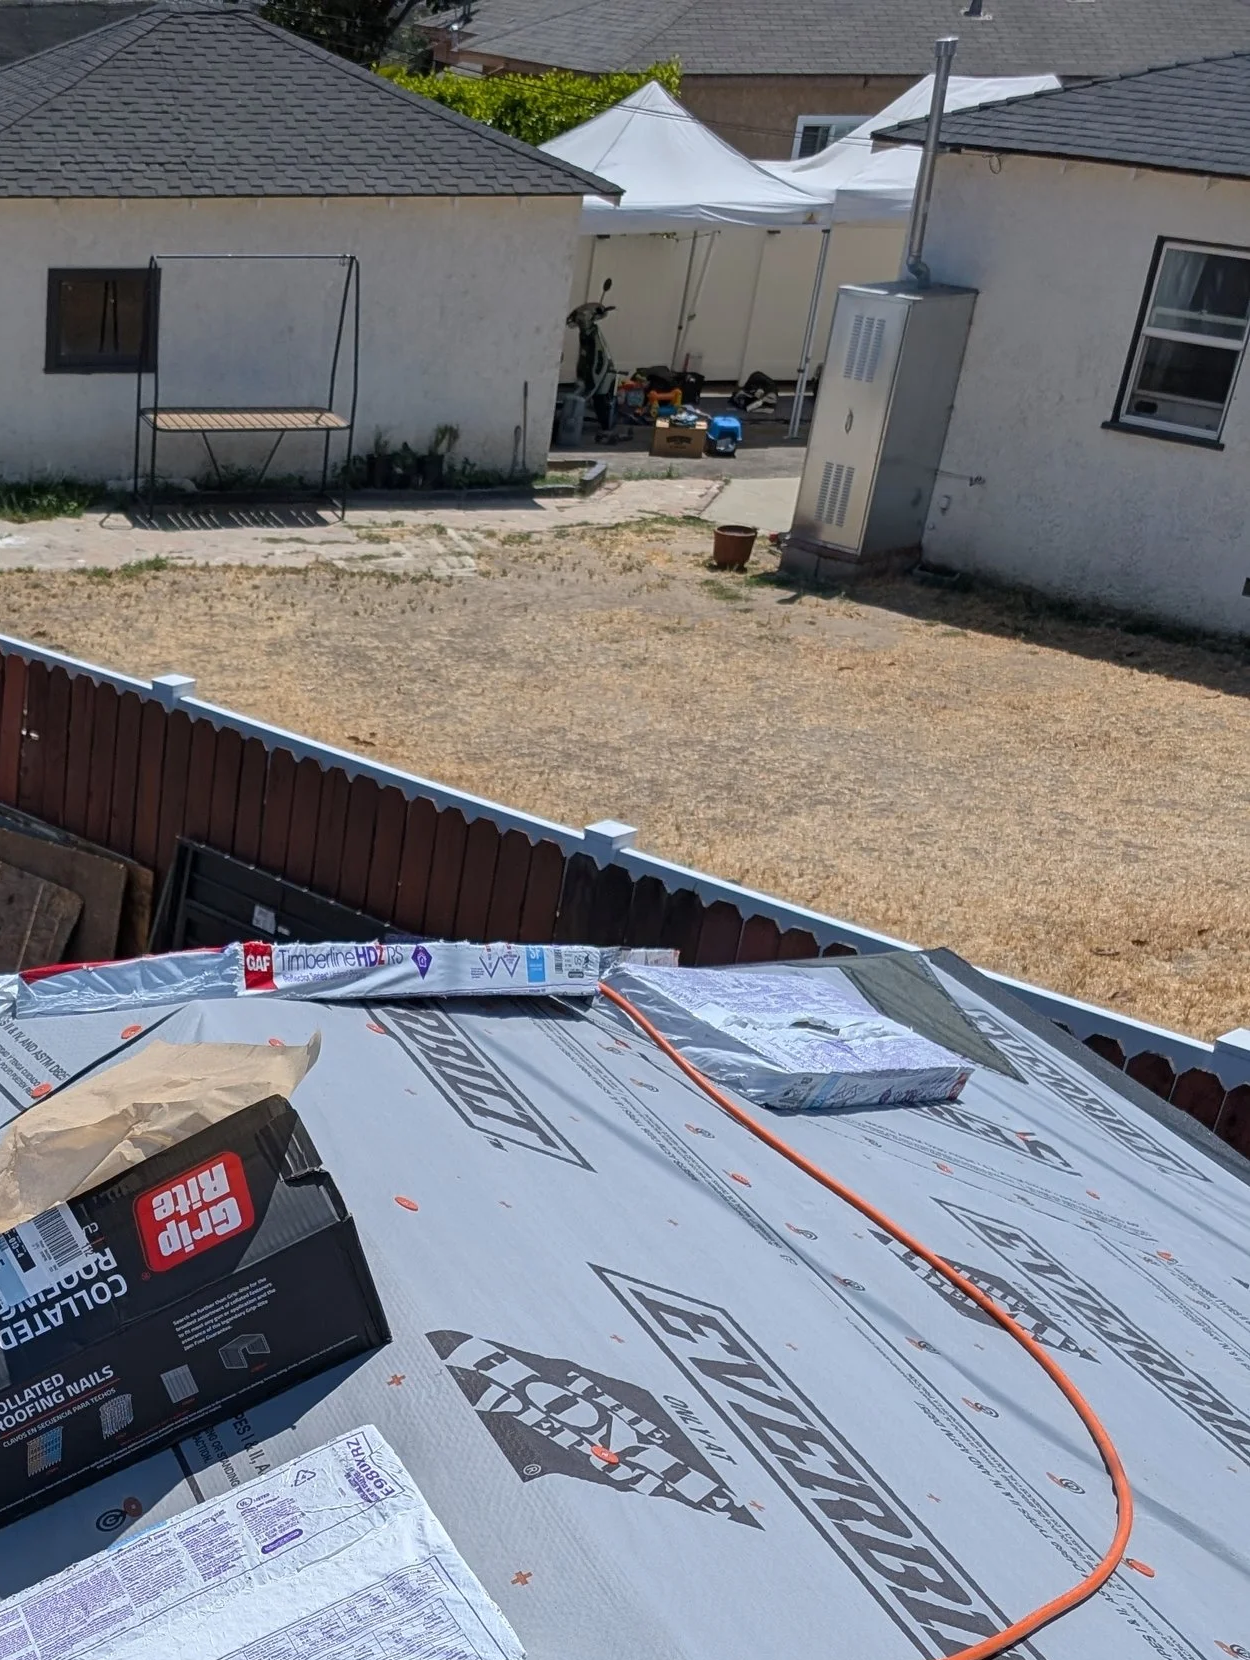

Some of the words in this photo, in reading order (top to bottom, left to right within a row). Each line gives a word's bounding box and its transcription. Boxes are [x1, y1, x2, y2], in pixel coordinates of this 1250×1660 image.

[247, 956, 271, 972] GAF
[152, 1162, 230, 1222] Rite
[158, 1197, 243, 1257] Grip
[67, 1365, 114, 1399] NAILS
[566, 1366, 672, 1445] THE
[3, 1433, 28, 1448] CLAVOS
[37, 1410, 73, 1434] SECUENCIA
[90, 1387, 117, 1405] TECHOS
[473, 1338, 743, 1532] HOME
[662, 1393, 713, 1438] ONLY
[706, 1435, 738, 1467] AT
[215, 1450, 240, 1487] STANDING
